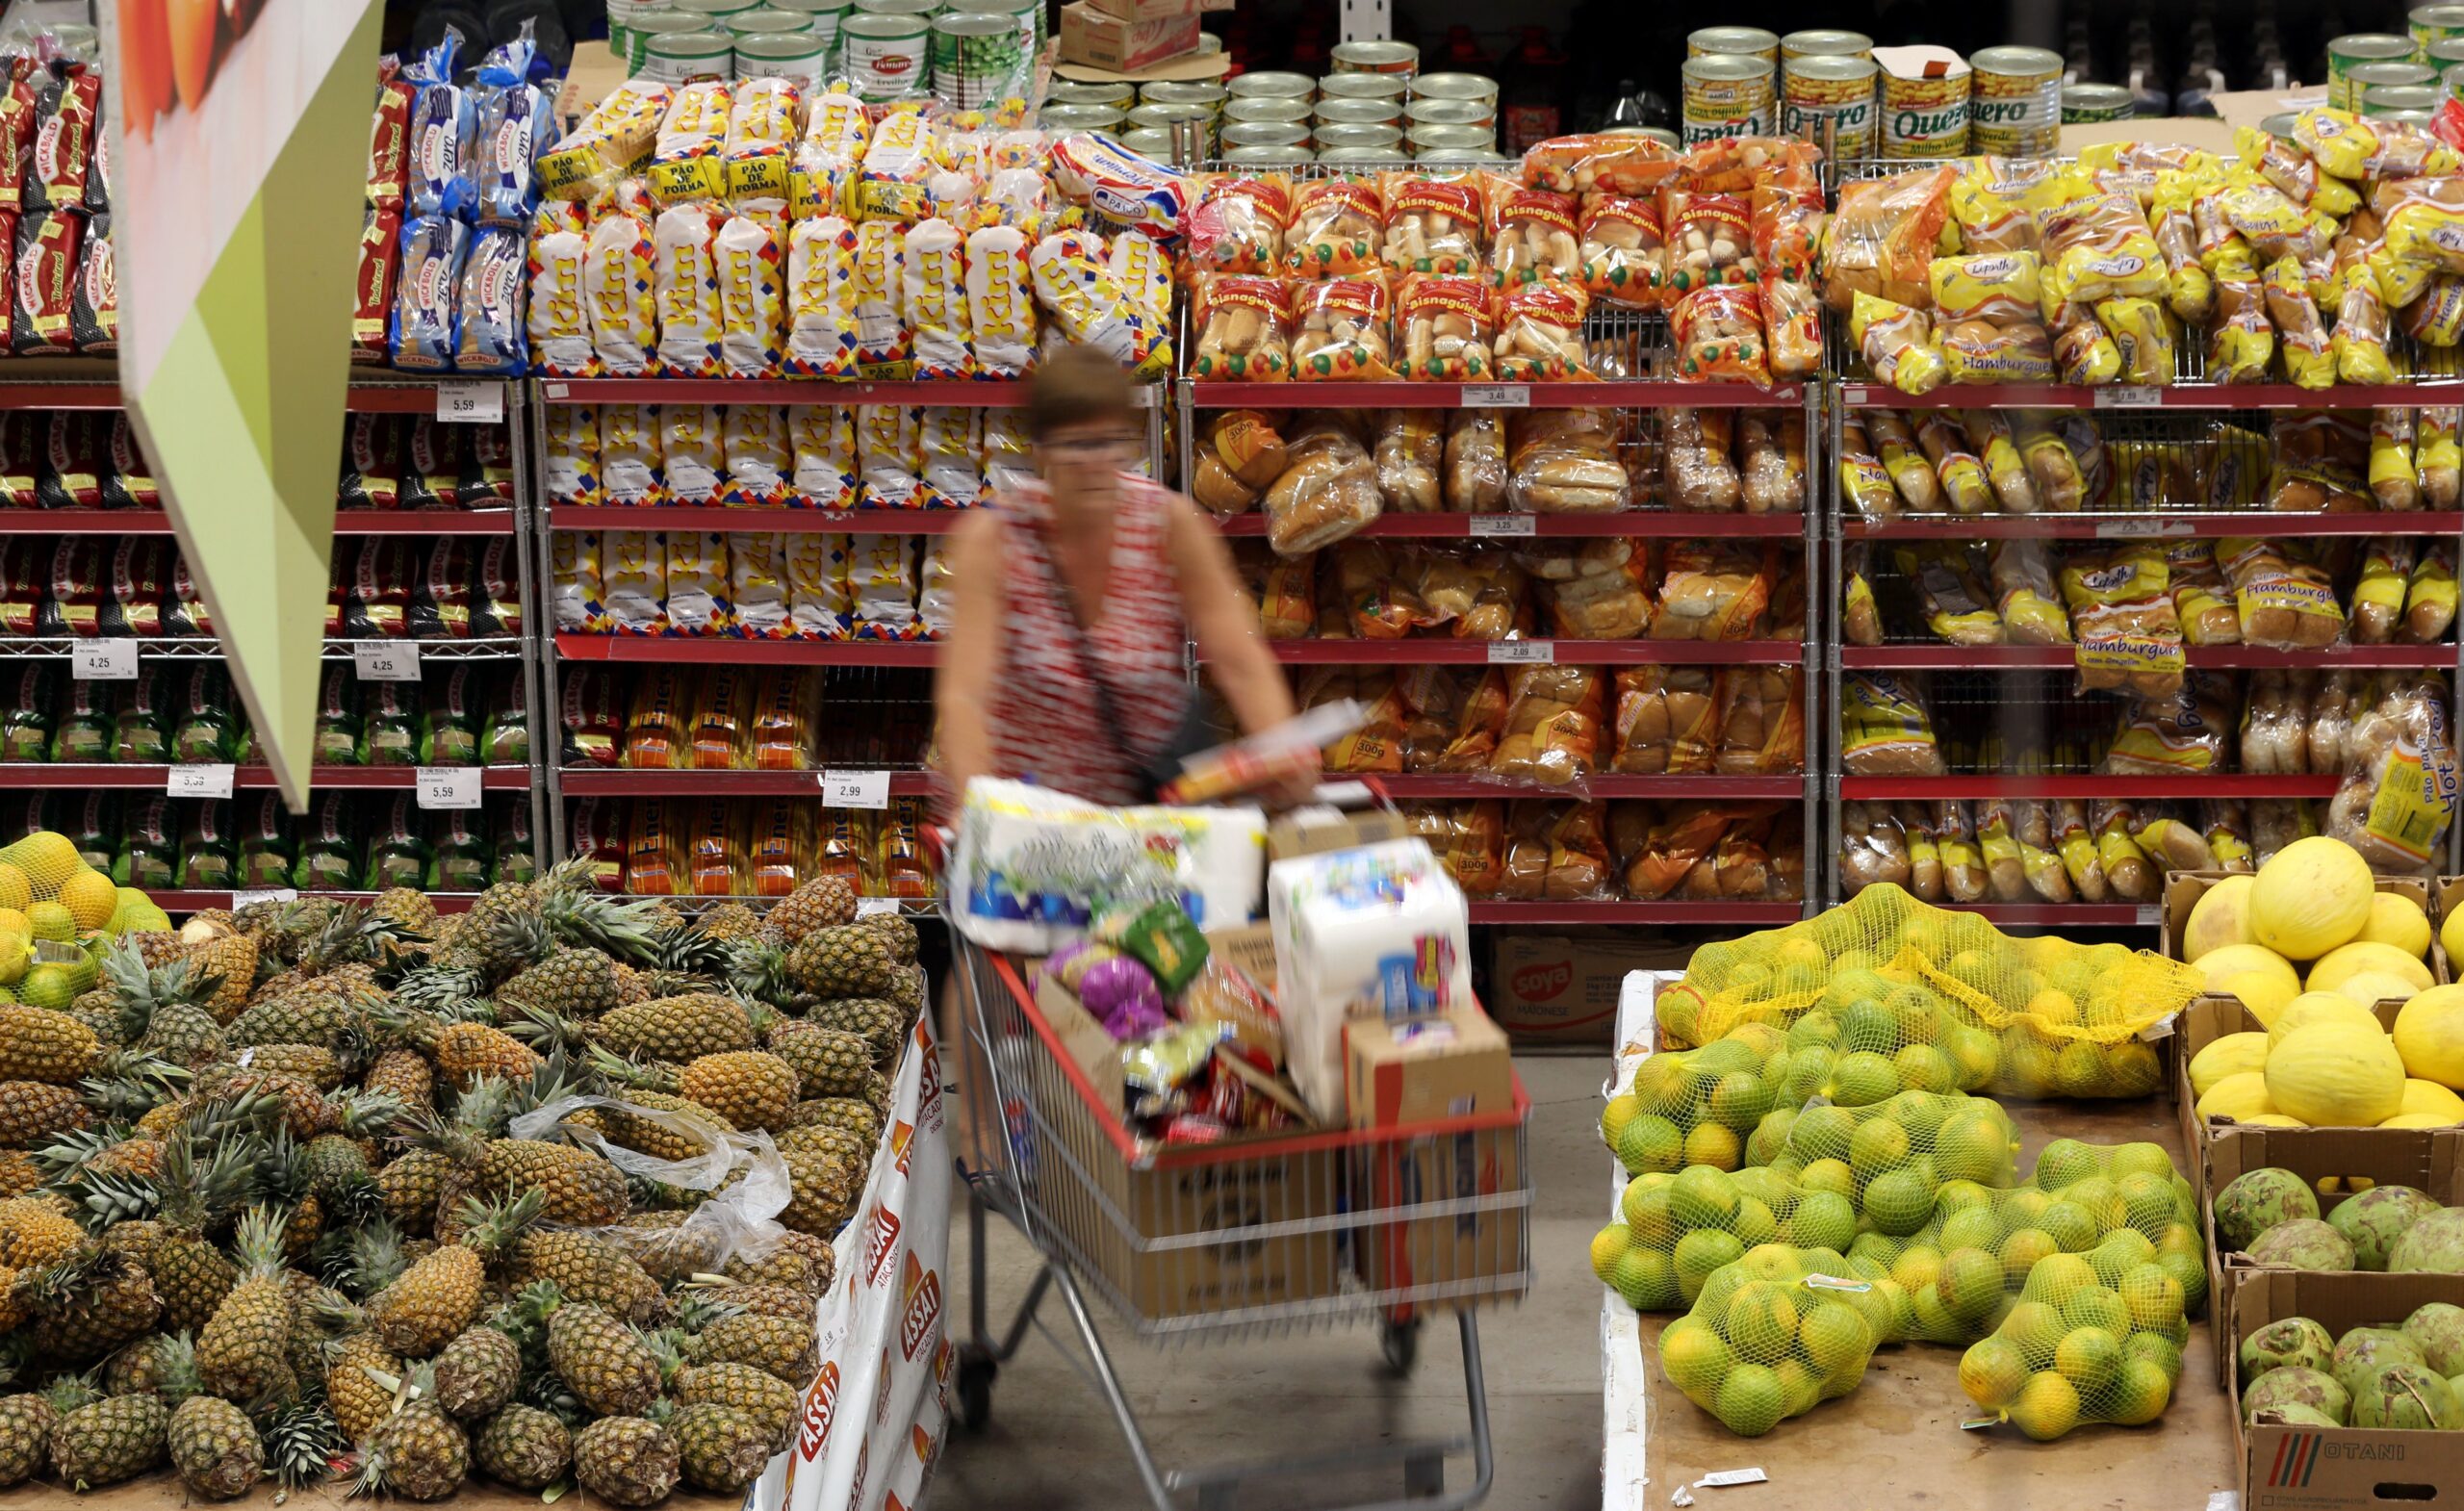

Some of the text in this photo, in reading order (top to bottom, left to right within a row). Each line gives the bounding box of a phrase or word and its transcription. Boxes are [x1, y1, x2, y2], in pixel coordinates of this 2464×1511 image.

[1911, 141, 1940, 154] Milho
[443, 136, 455, 173] zero
[551, 156, 575, 168] PÃO
[741, 162, 767, 174] PÃO
[559, 166, 573, 176] DE
[670, 163, 695, 175] PÃO
[748, 172, 763, 182] DE
[663, 180, 706, 194] FORMA
[735, 179, 779, 192] FORMA
[52, 252, 64, 302] Tradicional
[369, 258, 385, 307] Tradicional
[485, 262, 500, 305] WICKBOLD
[1489, 392, 1505, 400] 3,49
[453, 399, 475, 412] 5,59
[1513, 648, 1528, 656] 2,09
[89, 657, 110, 669] 4,25
[372, 661, 393, 672] 4,25
[1357, 742, 1385, 757] 300g
[2418, 738, 2434, 805] Pão para
[433, 786, 453, 798] 5,59
[840, 785, 860, 797] 2,99
[2439, 761, 2456, 813] Hot
[1461, 859, 1488, 870] 300g
[1517, 967, 1567, 994] soya
[1519, 1006, 1570, 1016] MAIONESE
[2324, 1443, 2404, 1460] OTANI
